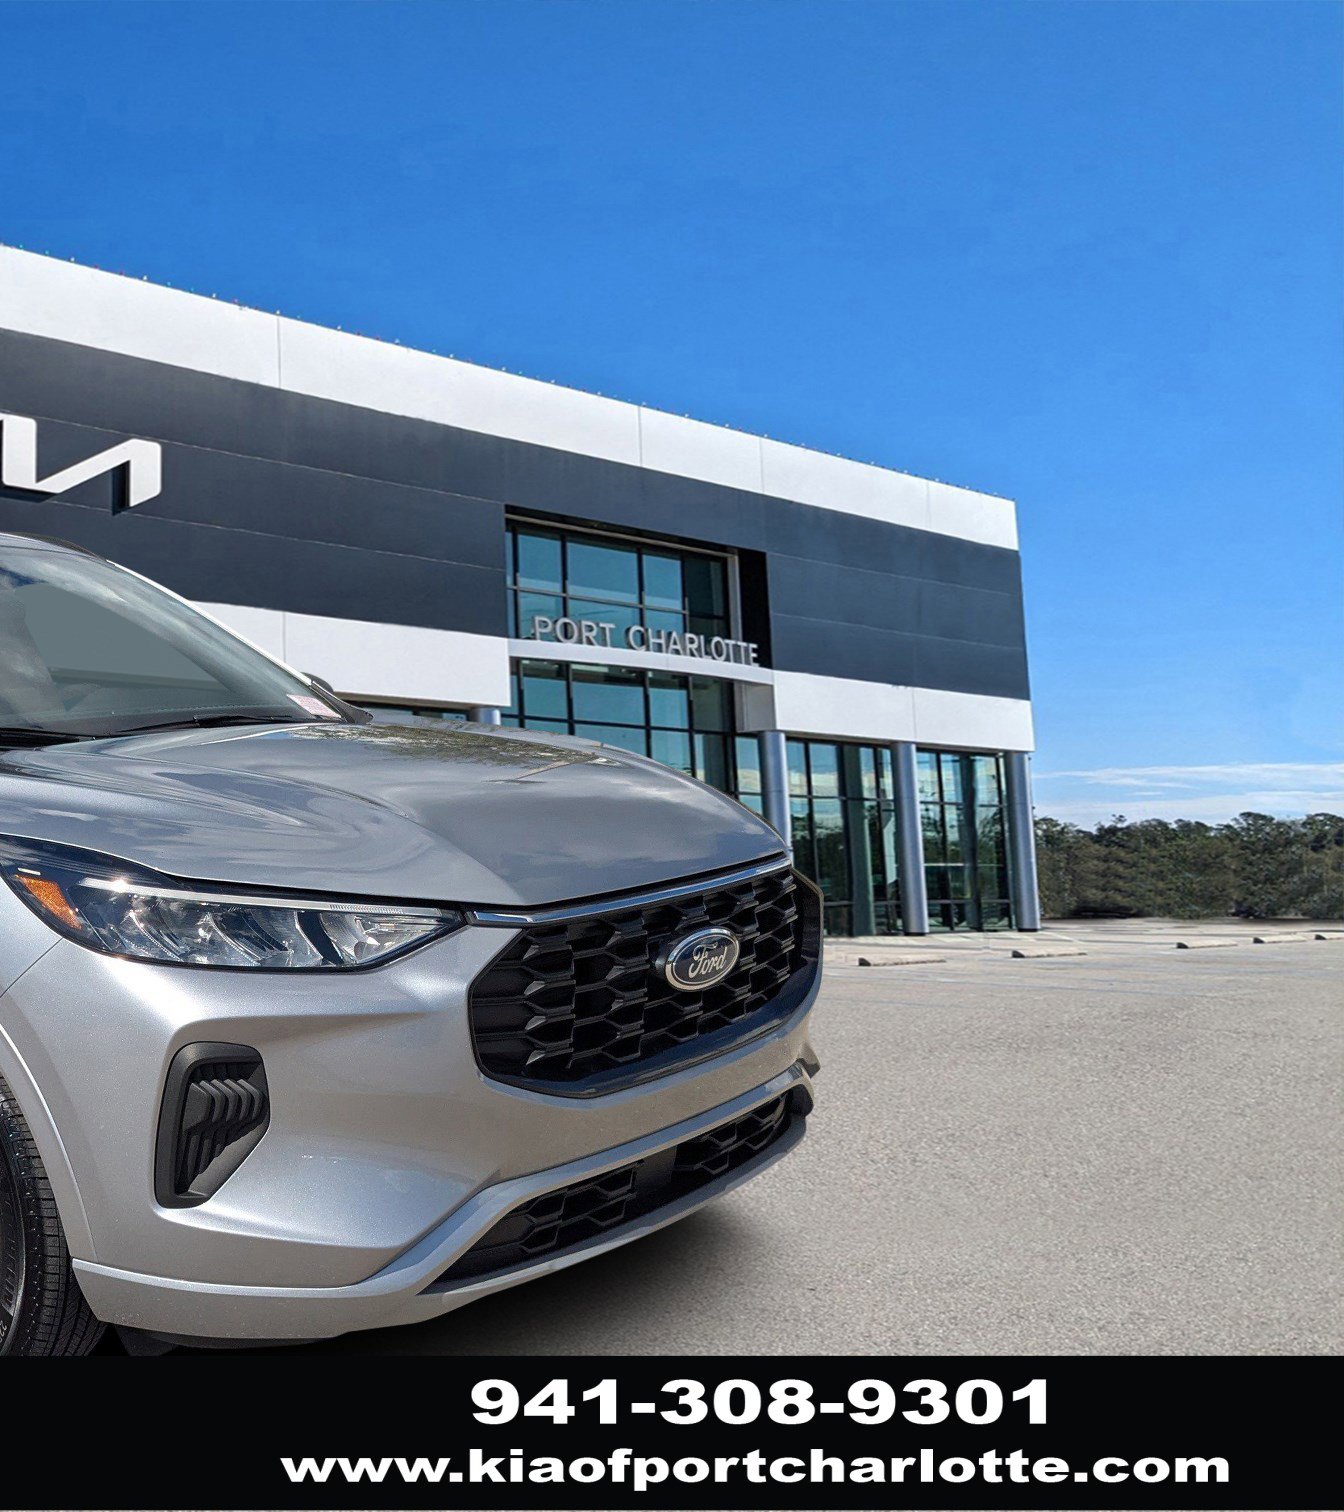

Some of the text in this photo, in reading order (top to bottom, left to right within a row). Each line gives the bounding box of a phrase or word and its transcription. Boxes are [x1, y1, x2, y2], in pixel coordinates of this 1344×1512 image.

[534, 615, 759, 667] PORT CHARLOTTE
[688, 941, 728, 979] Ford
